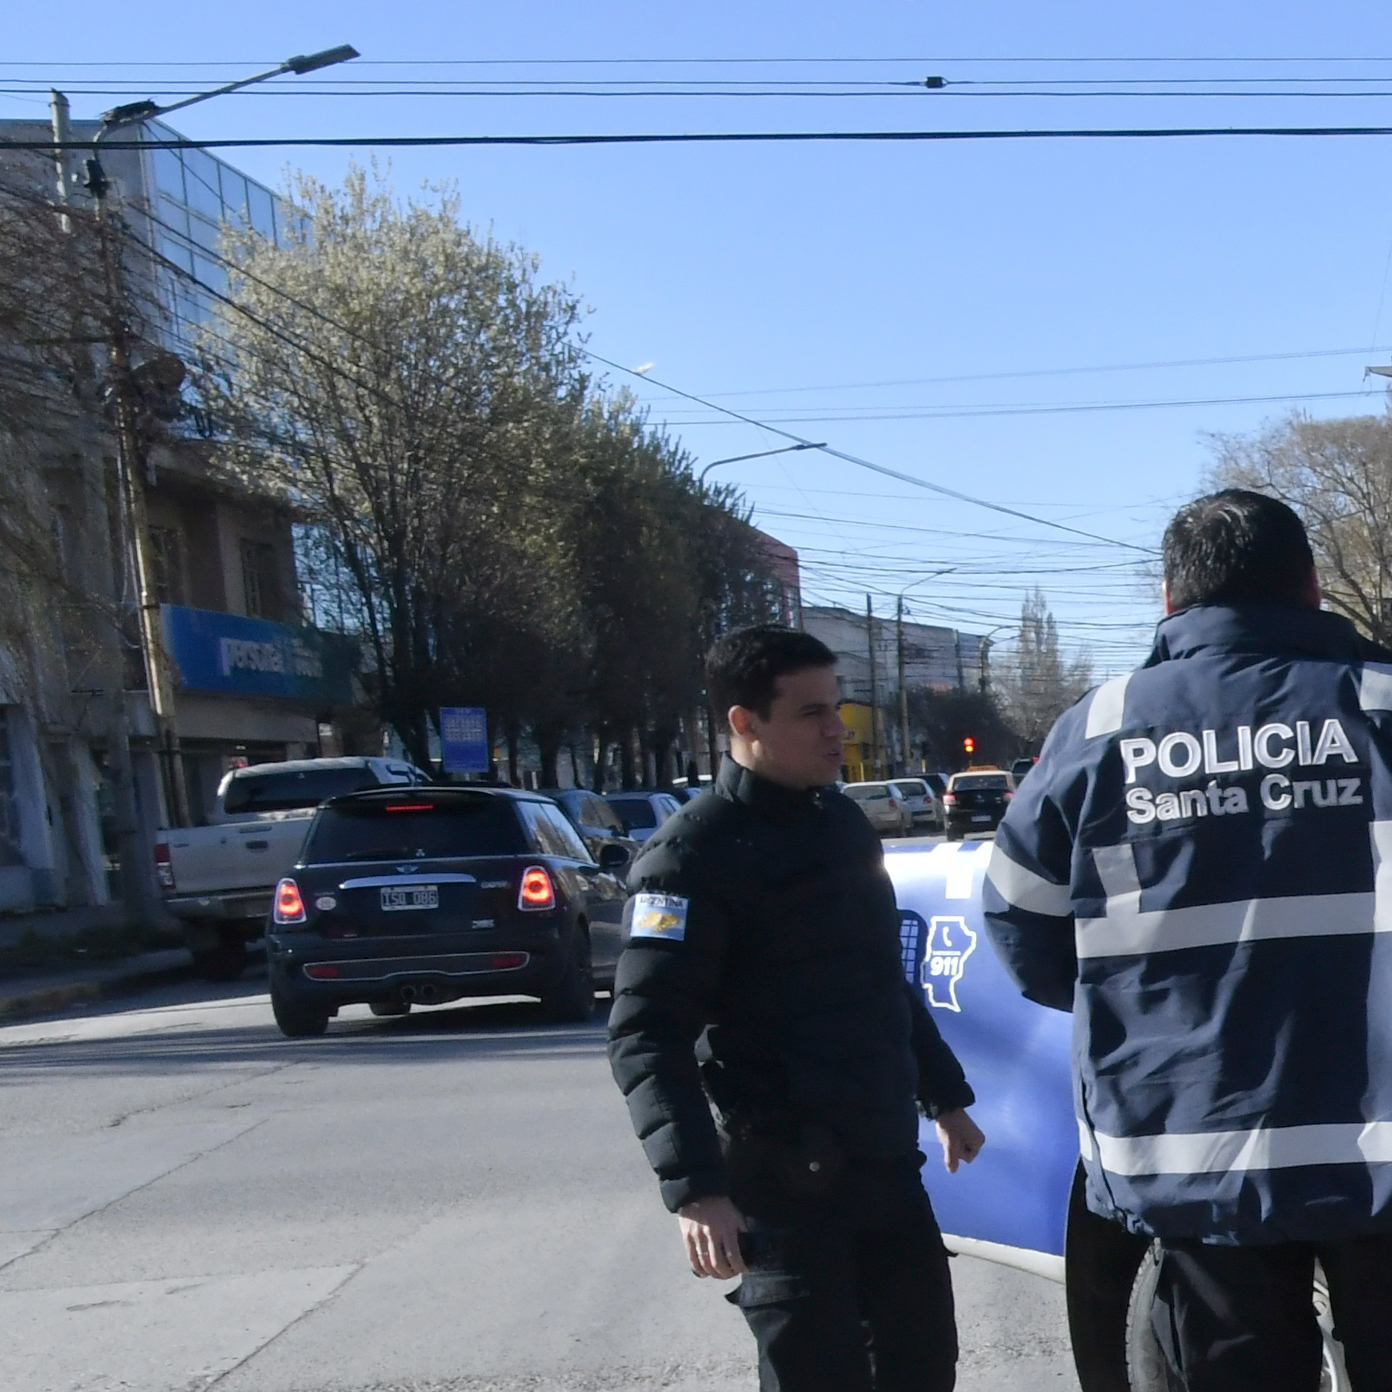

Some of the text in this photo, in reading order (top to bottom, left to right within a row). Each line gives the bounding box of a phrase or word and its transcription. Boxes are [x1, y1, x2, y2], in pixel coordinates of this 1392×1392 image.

[1120, 719, 1359, 784] POLICIA
[1126, 773, 1363, 824] Santa Cruz
[930, 956, 959, 976] 911
